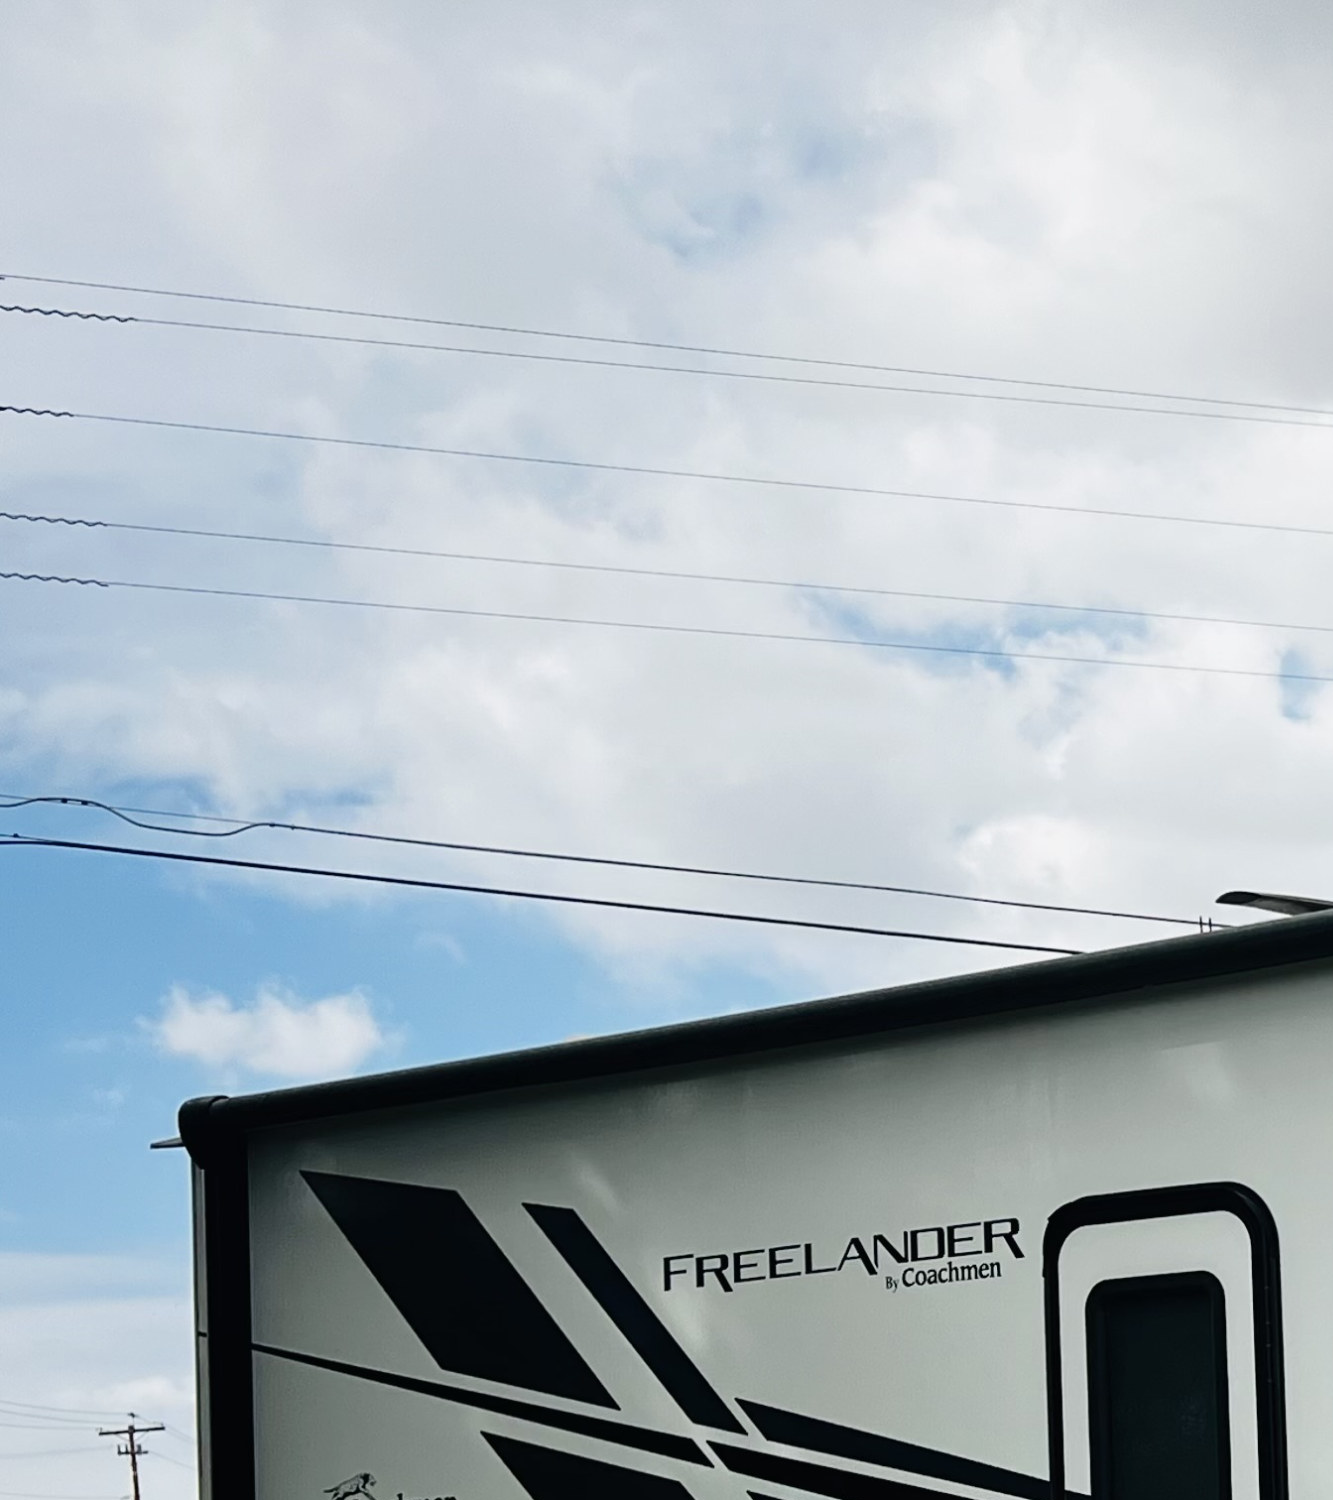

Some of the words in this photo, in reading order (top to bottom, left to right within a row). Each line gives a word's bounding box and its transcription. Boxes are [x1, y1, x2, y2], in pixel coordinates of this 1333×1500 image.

[663, 1217, 1025, 1292] FREELANDER
[885, 1275, 899, 1293] By
[902, 1259, 1002, 1287] Coachmen
